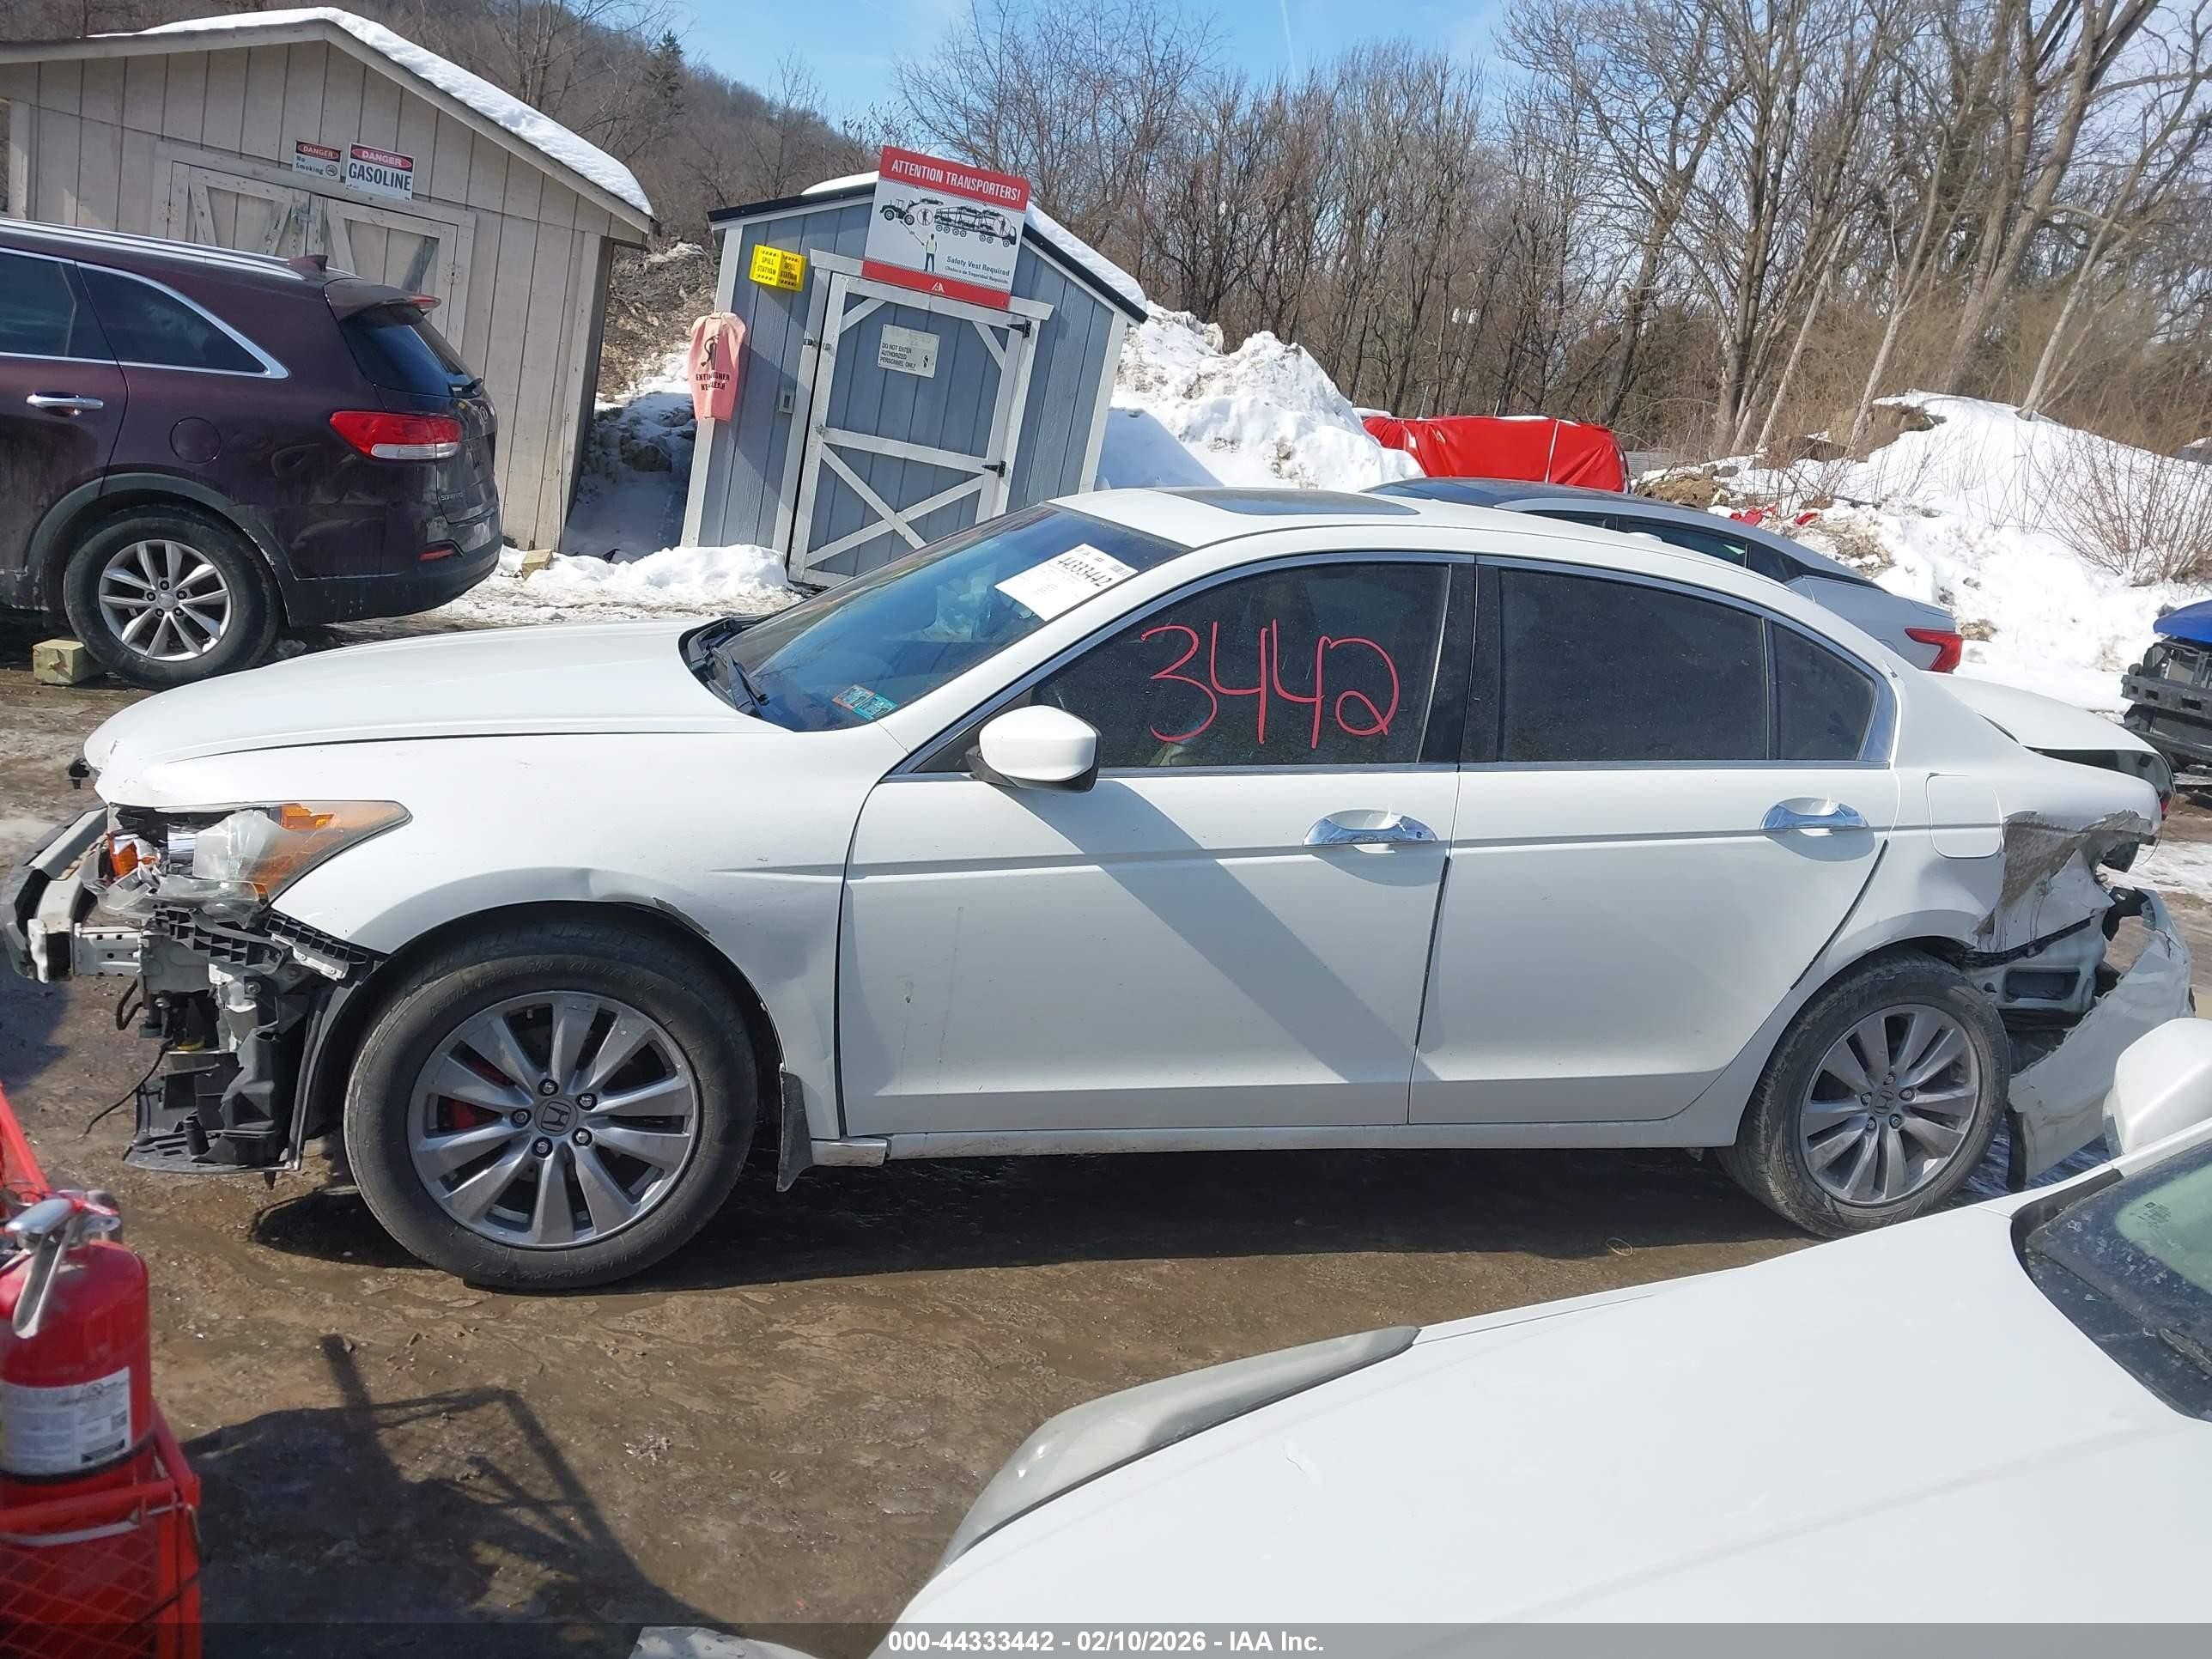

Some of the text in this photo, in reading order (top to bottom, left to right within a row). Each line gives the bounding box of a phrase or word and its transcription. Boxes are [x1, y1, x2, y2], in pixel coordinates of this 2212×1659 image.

[303, 145, 333, 158] DANGER
[362, 150, 402, 167] DANGER
[295, 162, 324, 175] Smoking
[349, 162, 412, 191] GASOLINE
[891, 159, 1021, 202] ATTENTION TRANSPORTERS!
[946, 256, 1010, 276] Safety Vest Required
[1057, 556, 1113, 586] 44333442
[1140, 618, 1400, 749] 3442
